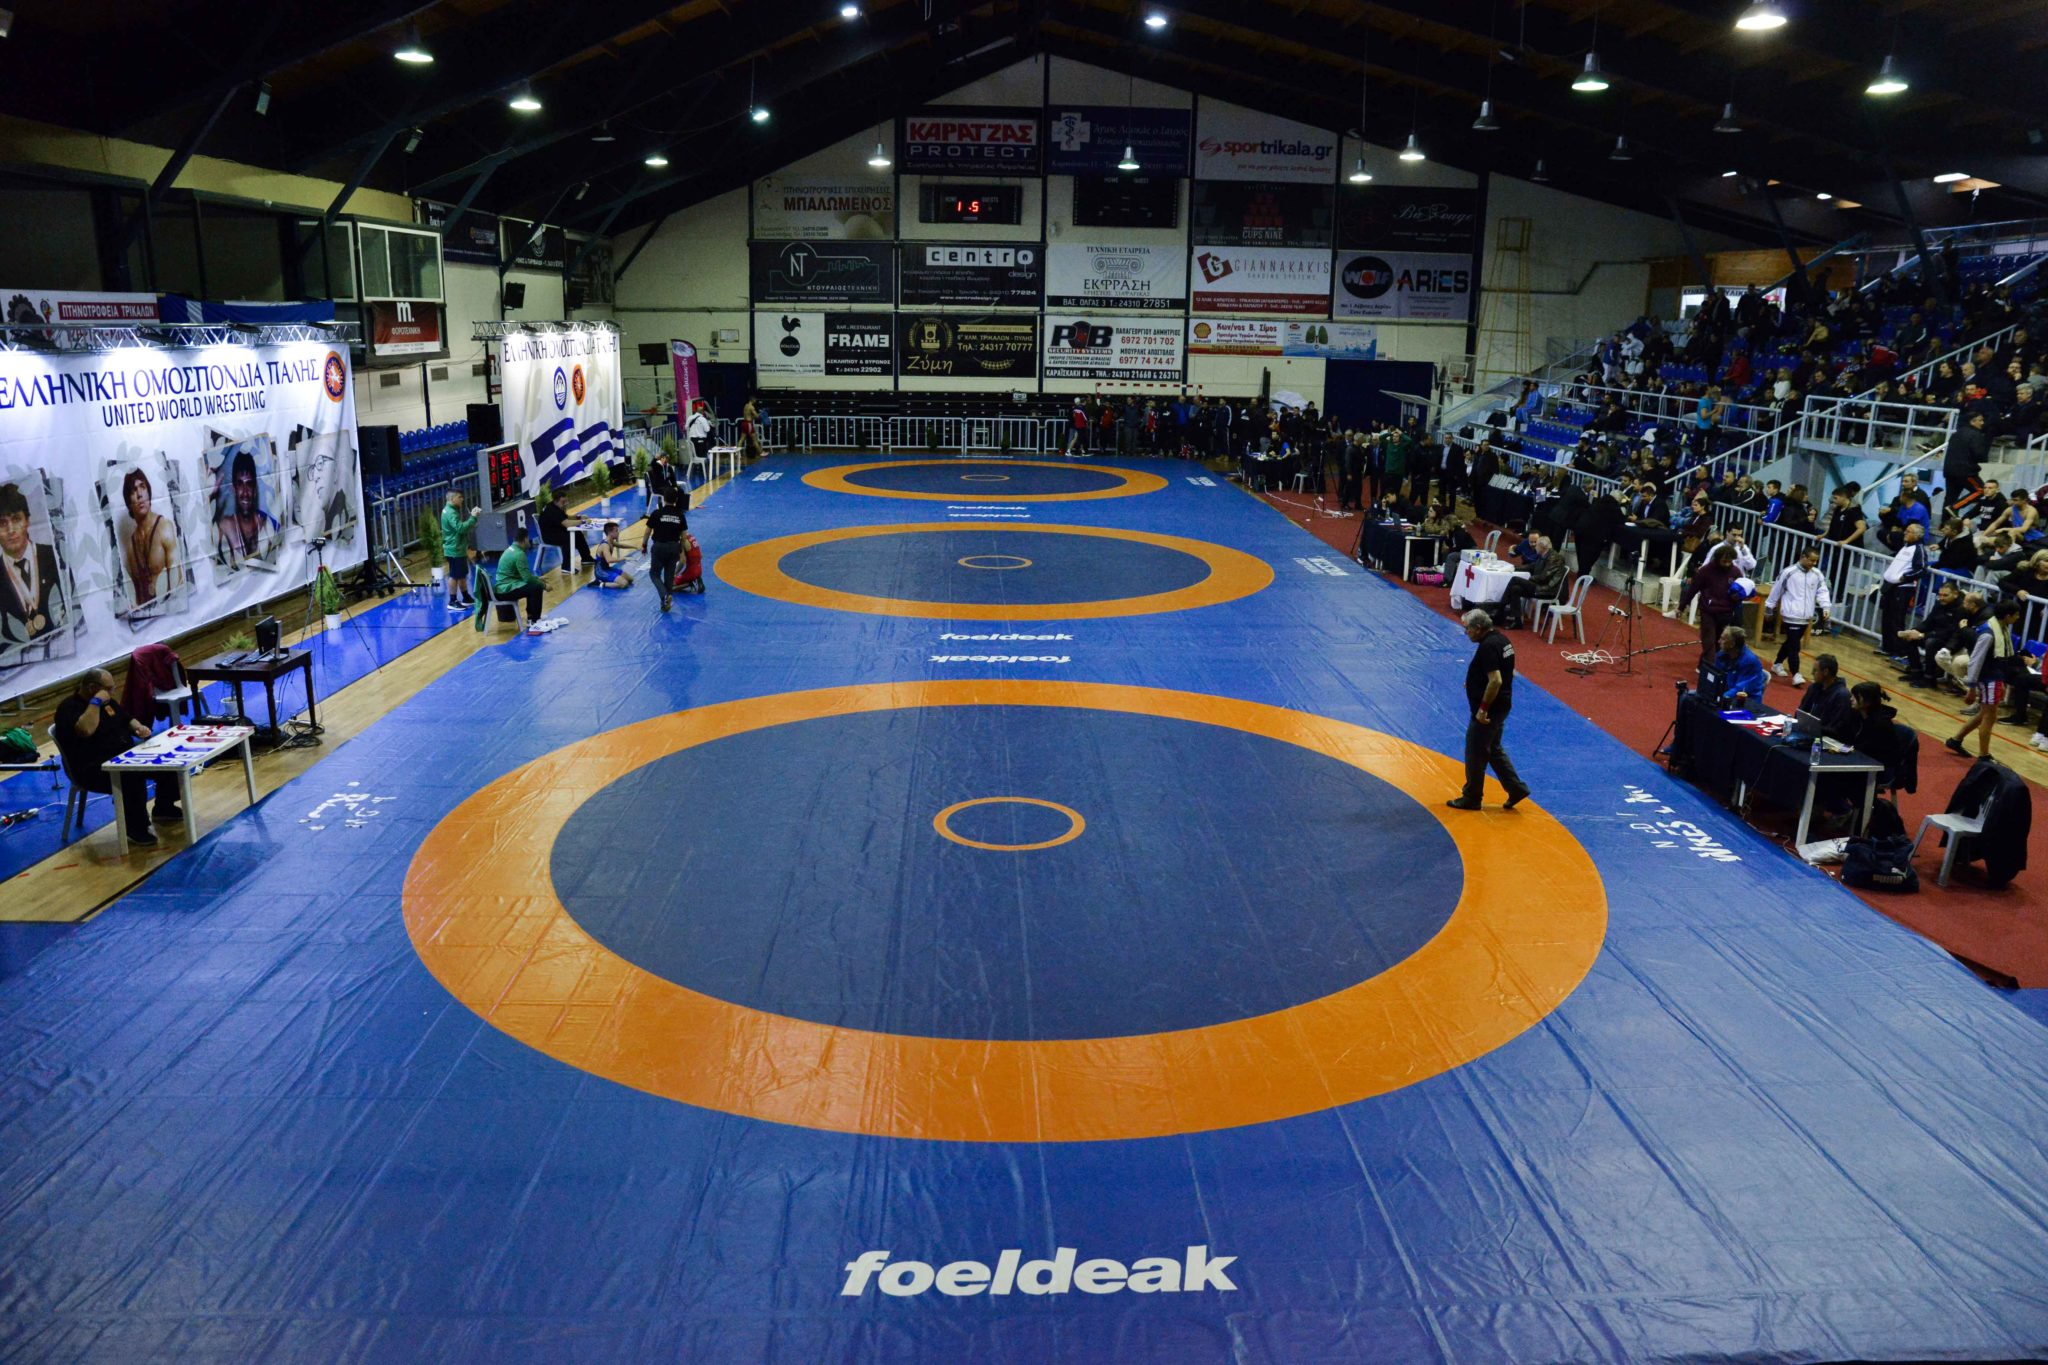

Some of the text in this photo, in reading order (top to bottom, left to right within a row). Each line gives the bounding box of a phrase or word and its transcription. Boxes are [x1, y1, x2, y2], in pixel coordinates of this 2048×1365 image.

[909, 122, 1033, 143] ΚΑΡΑΤΖΑΣ
[910, 145, 1032, 158] PROTECT
[1223, 140, 1333, 160] sportrikala.gr
[784, 196, 891, 211] ΜΠΑΛΩΜΕΝΟΣ
[1086, 246, 1118, 254] ΤΕΧΝΙΚΗ
[930, 249, 1034, 266] centro
[1234, 258, 1330, 274] GIANNAKAKIS
[1084, 278, 1151, 291] ΕΚΦΡΑΣΗ
[1143, 299, 1171, 308] 27851
[61, 304, 155, 318] ΠΤΗΝΟΤΡΟΦΕΙΑ ΤΡΙΚΑΛΩΝ
[1217, 323, 1246, 333] Κων/νος
[980, 343, 1003, 352] 24317
[1006, 343, 1033, 352] 70777
[1121, 336, 1175, 346] 6972 701 702
[906, 354, 953, 375] Ζύμη
[1119, 356, 1176, 366] 6977 74 74 47
[1159, 371, 1180, 380] 26310
[0, 358, 320, 410] ΕΛΛΗΝΙΚΗ ΟΜΟΣΠΟΝΔΙΑ ΠΑΛΗΣ
[103, 390, 266, 427] UNITED WORLD WRESTLING
[940, 633, 1073, 641] foeldeak
[840, 1245, 1238, 1296] foeldeak
